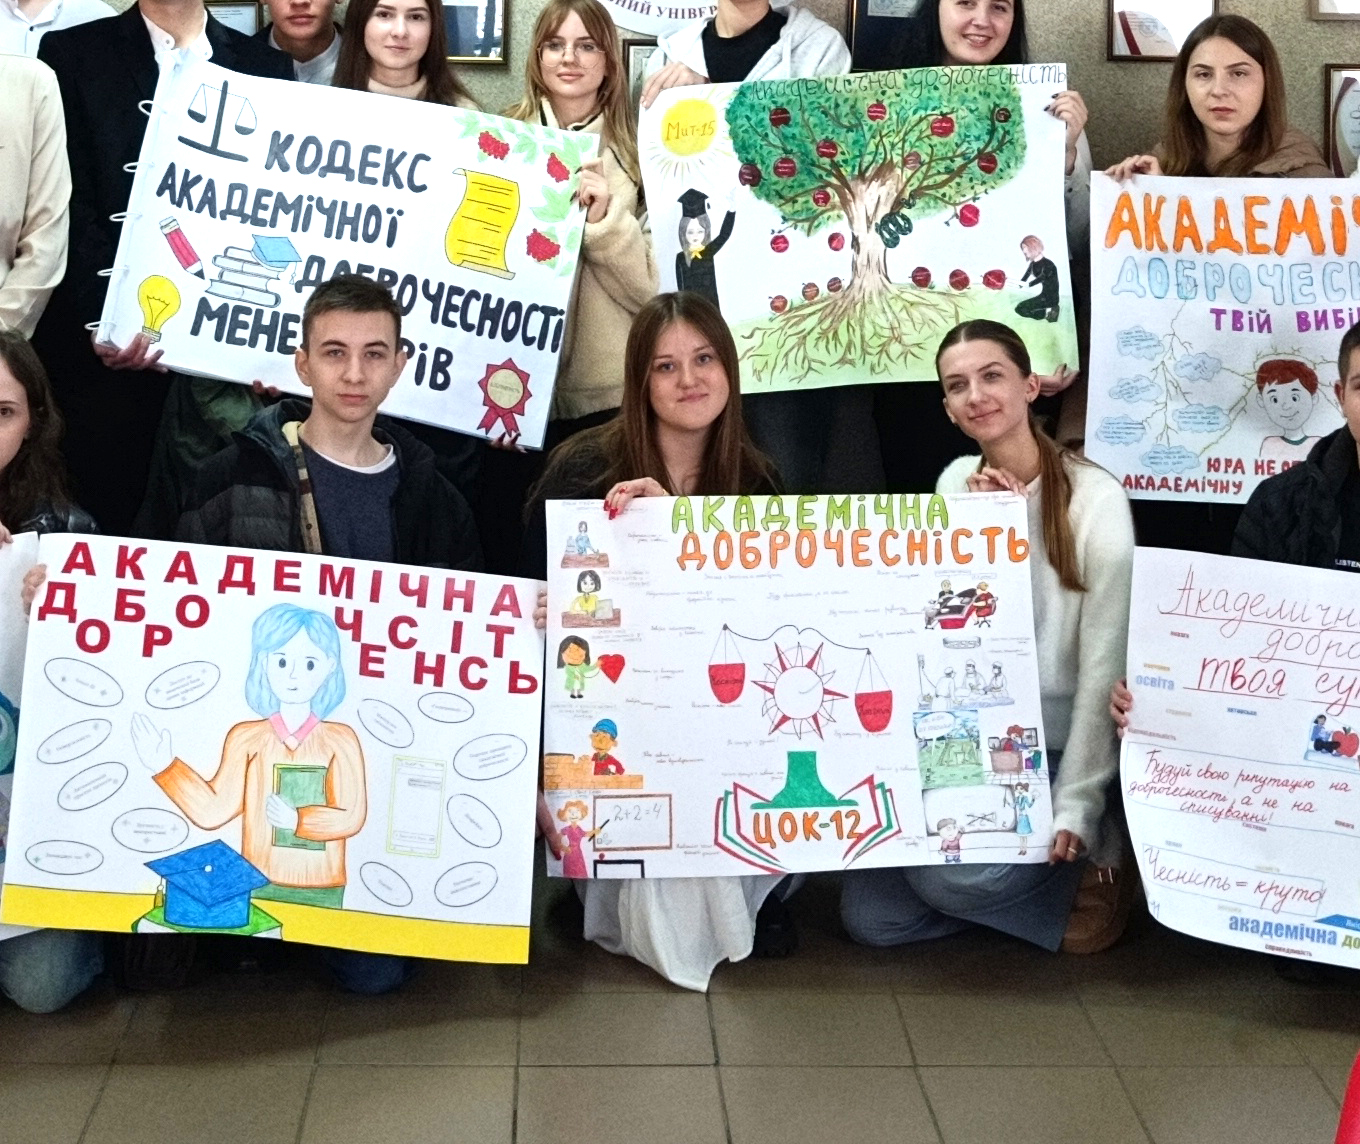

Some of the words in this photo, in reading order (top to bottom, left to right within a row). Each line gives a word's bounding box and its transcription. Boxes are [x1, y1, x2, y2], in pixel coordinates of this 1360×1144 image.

[655, 4, 718, 20] УНІВЕР
[263, 130, 432, 194] КОДЕКС
[155, 161, 406, 249] АКАДЕМІЧНОЇ
[1209, 307, 1274, 334] ТВІЙ
[1122, 474, 1243, 495] АКАДЕМІЧНУ
[1207, 457, 1246, 475] ЮРА
[1254, 458, 1276, 476] НЕ
[671, 494, 950, 535] АКАДЕМІЧНА
[676, 526, 1031, 571] ДОБРОЧЕСНІСТЬ
[1335, 558, 1360, 568] LISTEN
[61, 541, 523, 619] АКАДЕМІЧНА
[1135, 674, 1175, 691] освіта
[1143, 749, 1192, 784] Будуй
[1197, 762, 1229, 780] свою
[1233, 769, 1315, 794] репутацію
[1329, 781, 1351, 792] на
[1241, 795, 1253, 806] а
[1262, 797, 1278, 809] не
[1291, 798, 1315, 813] на
[752, 808, 862, 850] ЦОК-12
[1144, 846, 1231, 891] Чесність
[1229, 915, 1338, 946] академічна
